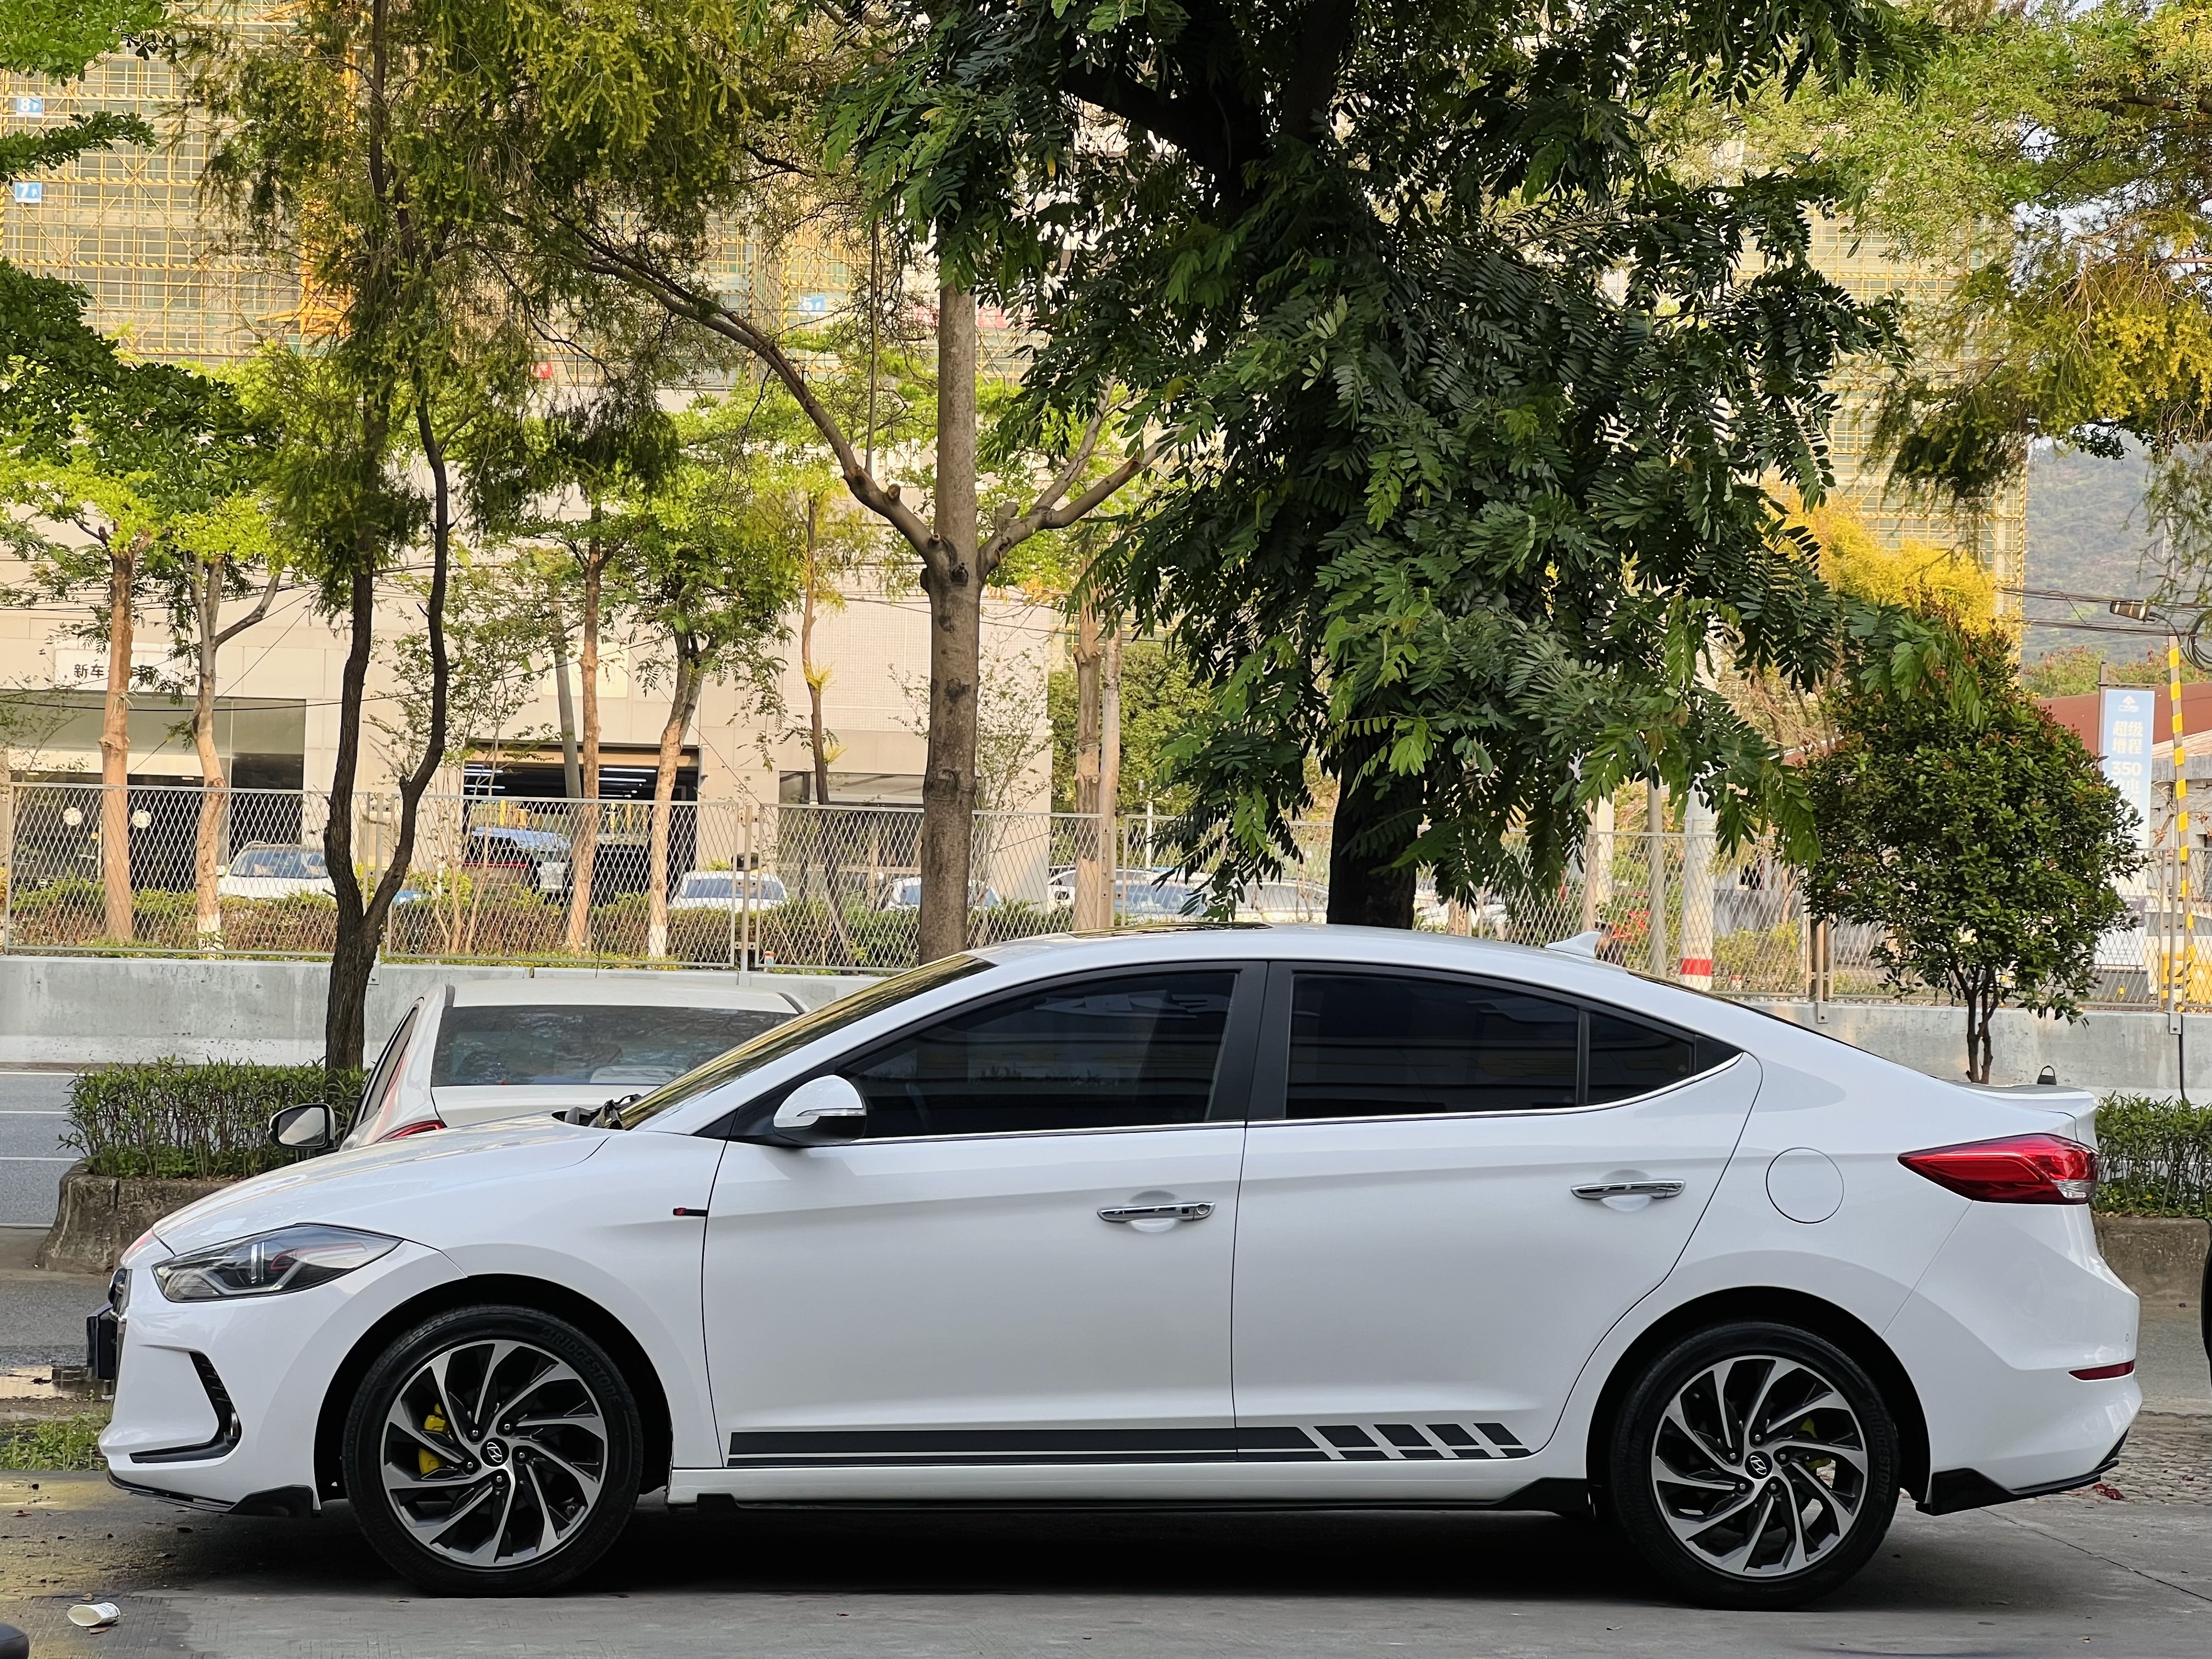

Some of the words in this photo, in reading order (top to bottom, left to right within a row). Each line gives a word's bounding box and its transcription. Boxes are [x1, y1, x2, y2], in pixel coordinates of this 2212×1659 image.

[20, 98, 40, 111] 8F
[74, 663, 109, 679] 新车
[2113, 720, 2143, 737] 超级
[2112, 761, 2141, 776] 350
[539, 1325, 621, 1404] BRIDGESTONE
